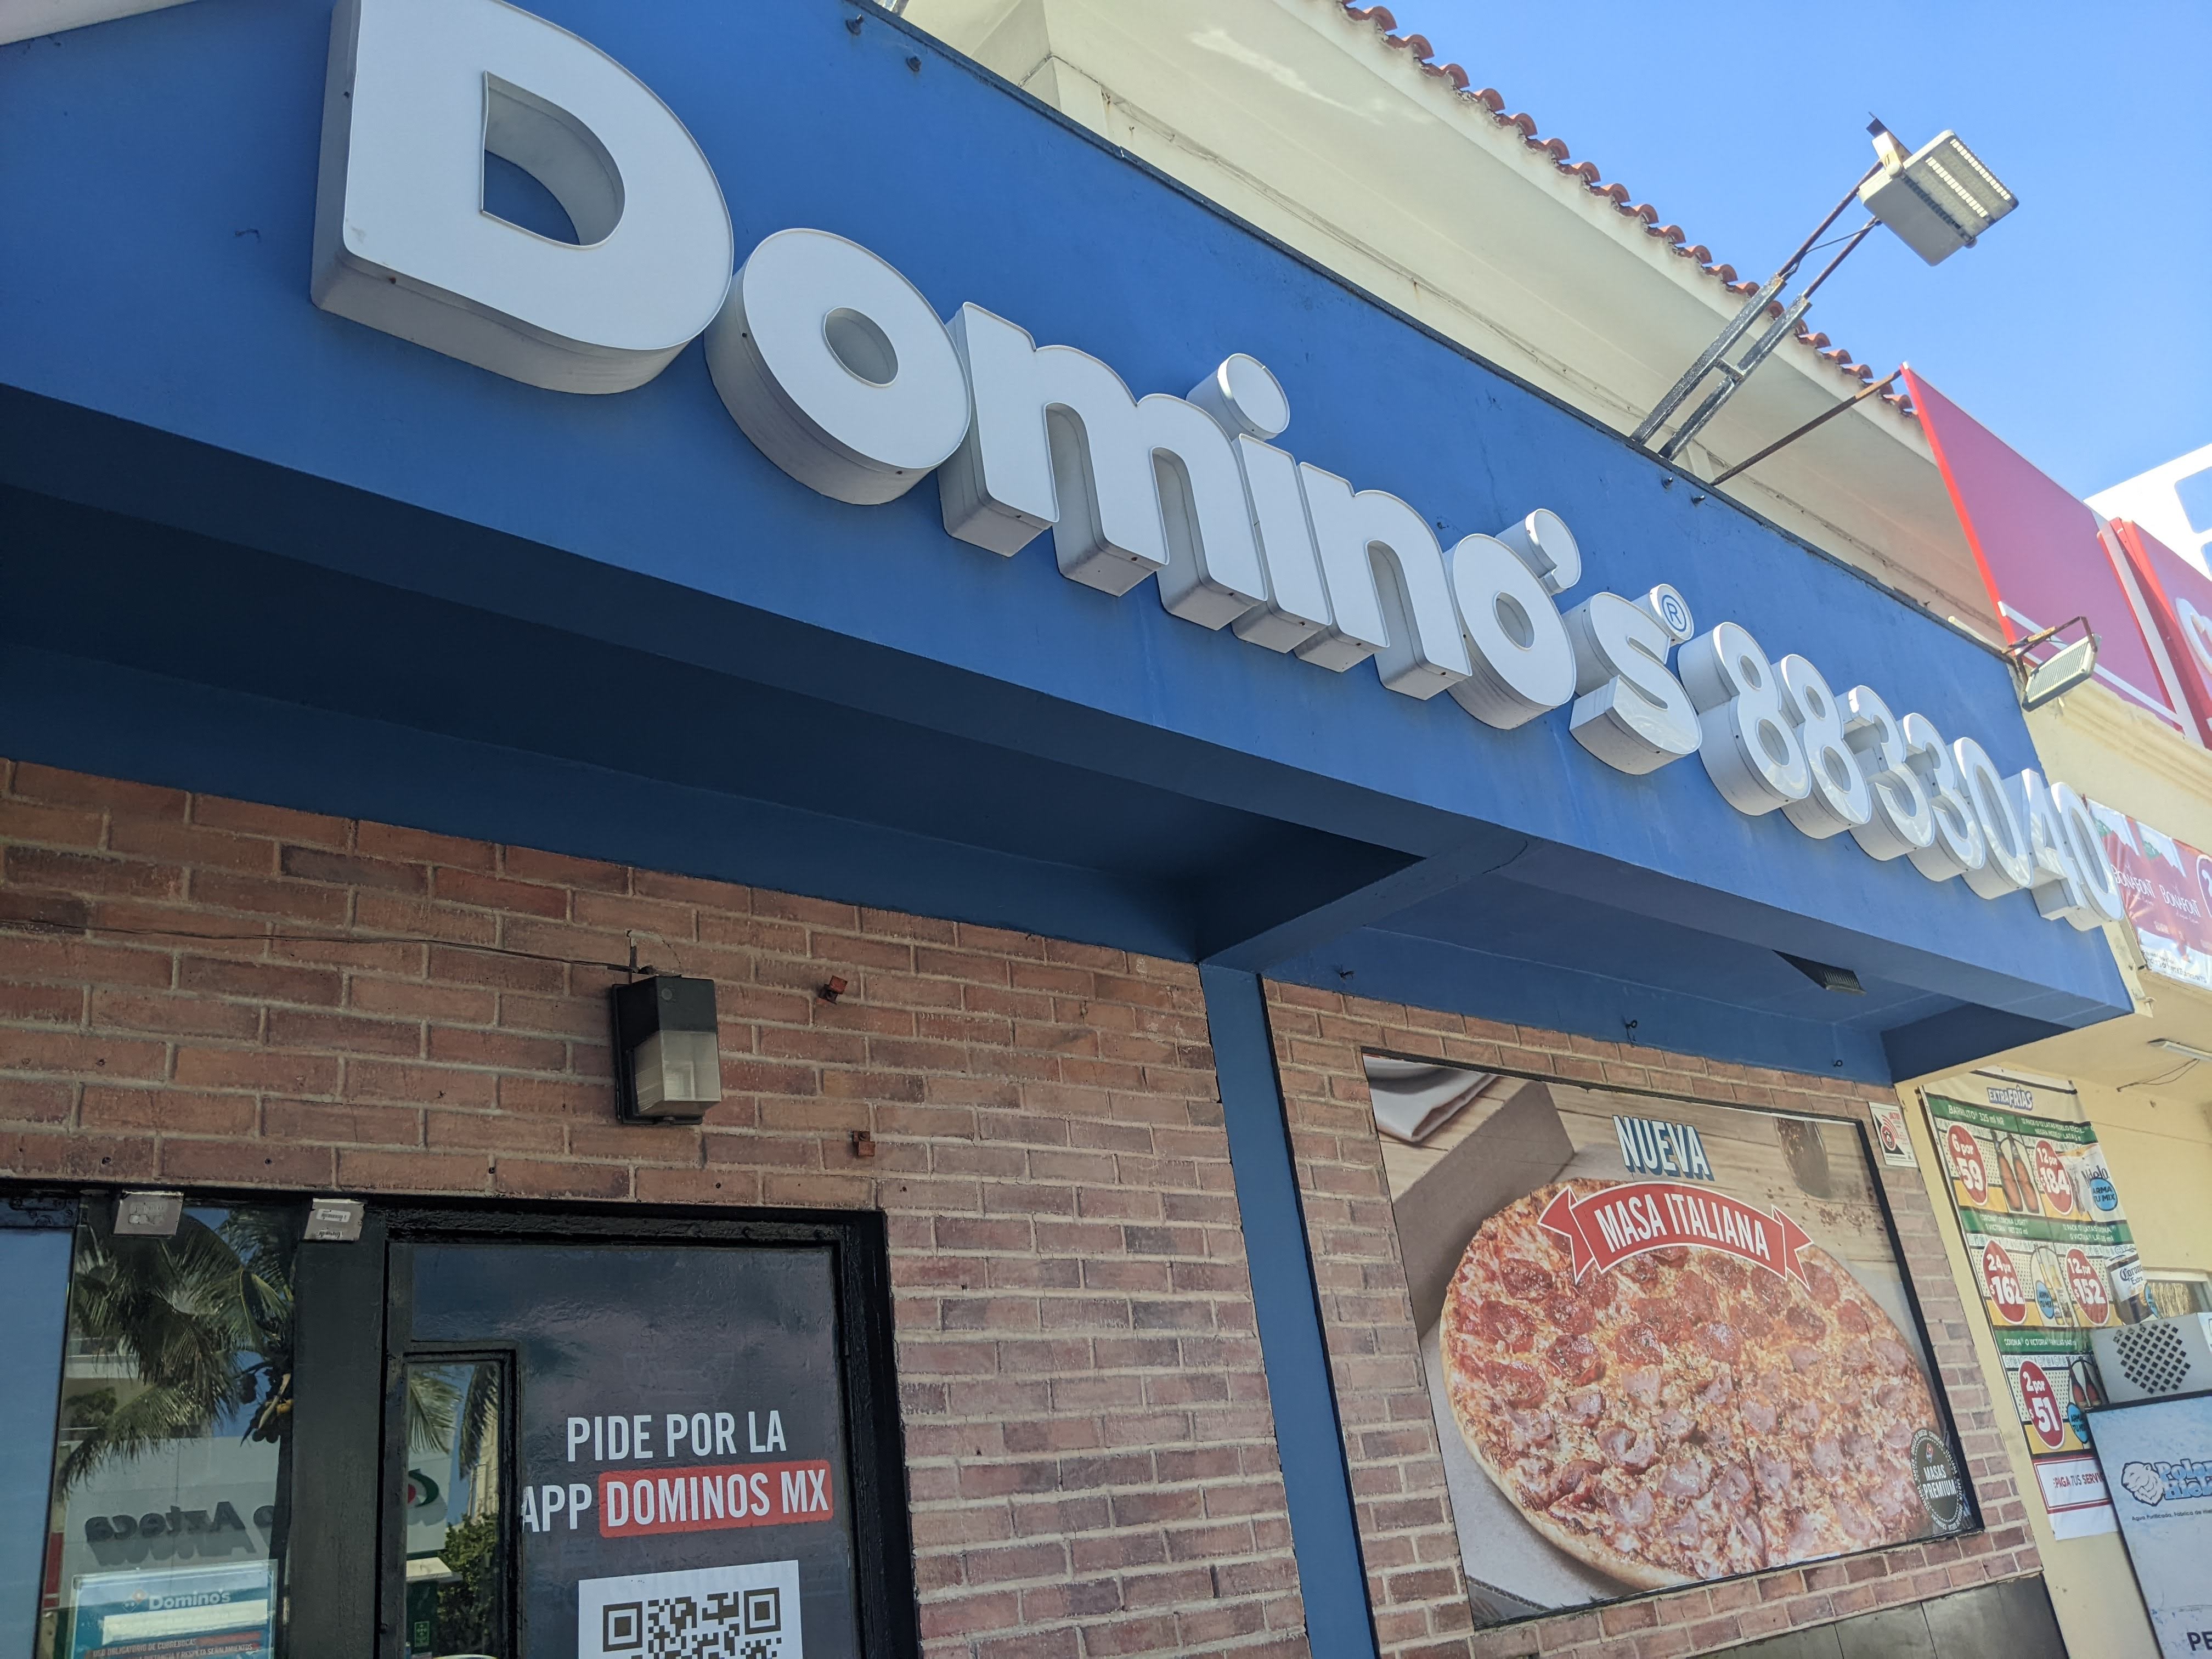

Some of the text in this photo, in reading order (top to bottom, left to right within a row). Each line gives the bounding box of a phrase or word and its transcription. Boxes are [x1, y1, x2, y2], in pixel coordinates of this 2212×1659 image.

[1706, 621, 2124, 923] 8833040
[2111, 864, 2155, 899] BONAFONT
[2159, 884, 2201, 917] BONAFONT
[1978, 1112, 1989, 1123] 325
[1613, 1115, 1714, 1181] NUEVA
[1951, 1133, 1973, 1156] 6 por
[2037, 1147, 2049, 1164] 12
[2093, 1185, 2112, 1194] ARMA
[2102, 1193, 2116, 1202] MIX
[1594, 1192, 1771, 1261] MASA ITALIANA
[1986, 1254, 2004, 1271] 24
[2067, 1258, 2083, 1273] 12
[1989, 1276, 2025, 1305] $162
[2022, 1371, 2046, 1394] 2 por
[567, 1409, 787, 1463] PIDE POR LA
[1923, 1464, 1947, 1481] MASAS
[1945, 1449, 1958, 1474] ITALIANA
[1922, 1479, 1958, 1499] PREMIUM
[2070, 1474, 2082, 1486] TUS
[522, 1469, 829, 1533] APP DOMINOS MX
[149, 1588, 231, 1611] Domino's
